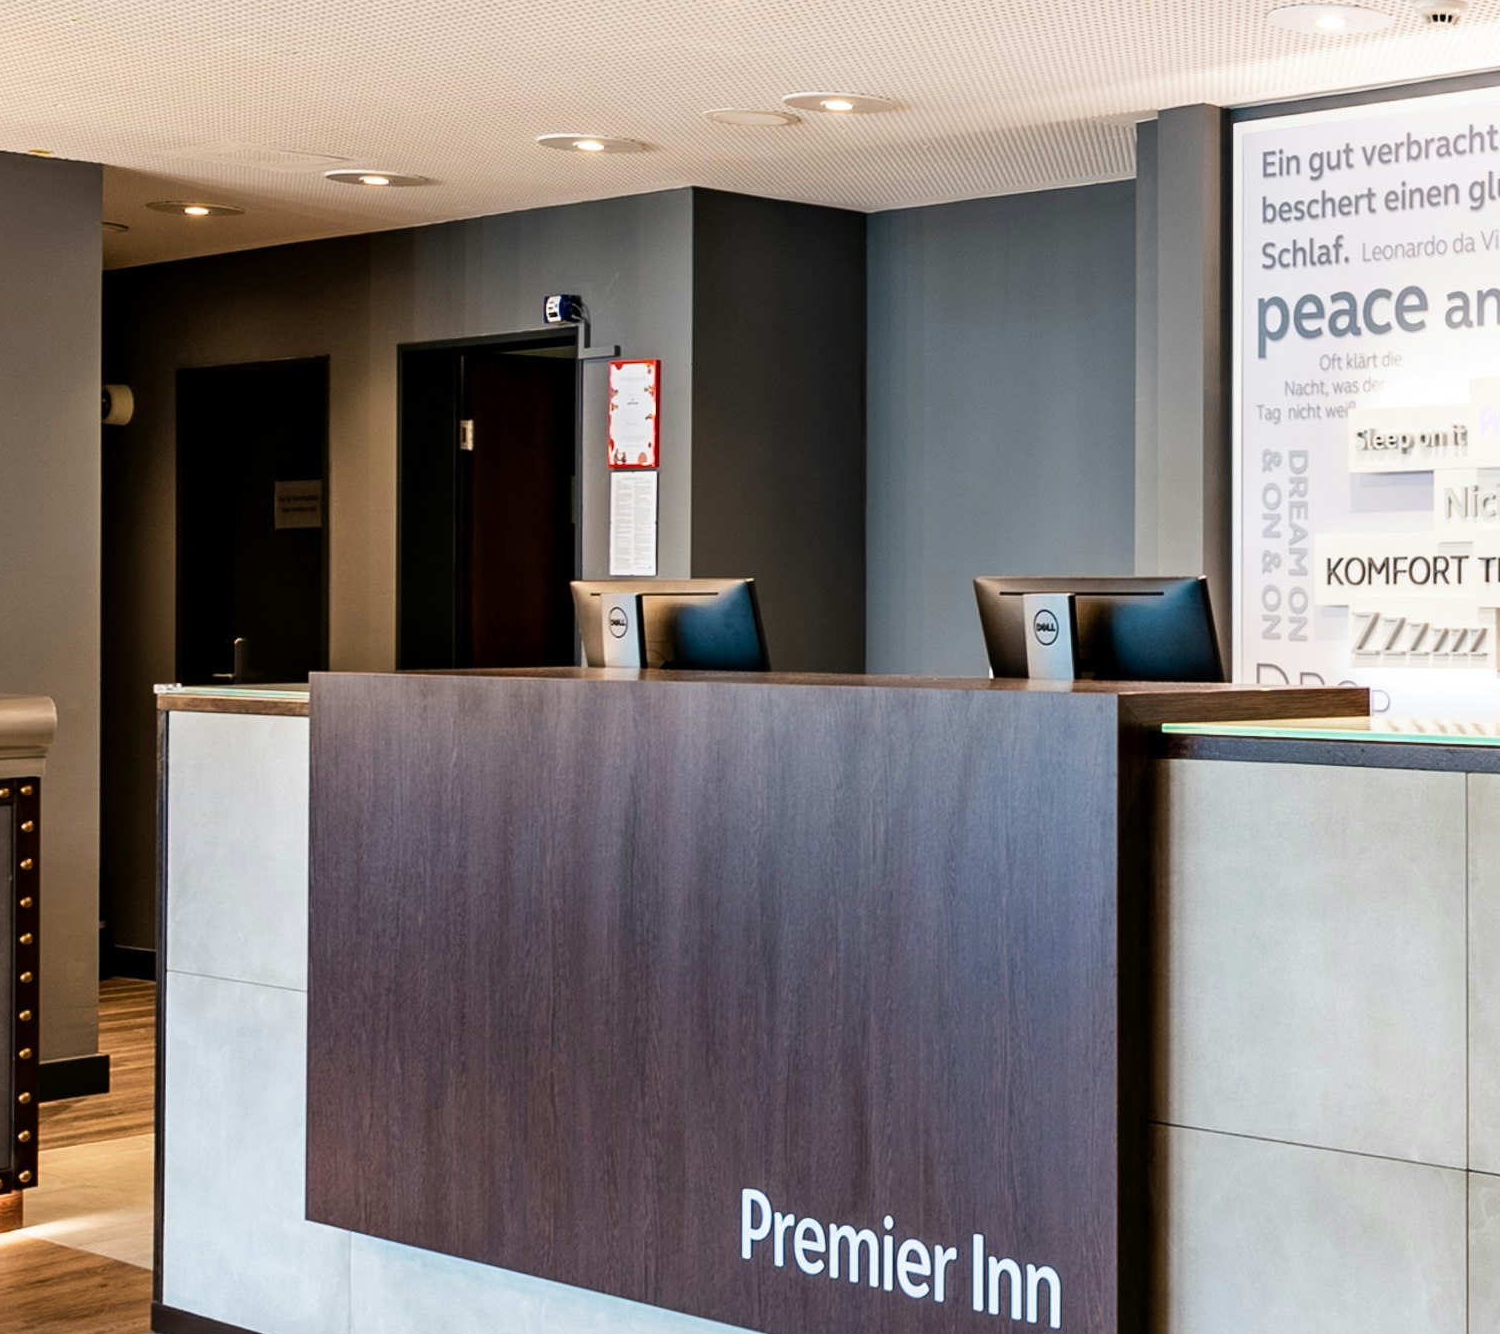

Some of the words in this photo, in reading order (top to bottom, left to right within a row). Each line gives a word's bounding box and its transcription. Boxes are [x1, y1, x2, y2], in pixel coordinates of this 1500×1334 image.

[1262, 149, 1300, 177] Ein
[1309, 142, 1353, 179] gut
[1262, 186, 1376, 223] beschert
[1384, 181, 1459, 212] einen
[1262, 235, 1349, 269] Schlaf.
[1362, 234, 1447, 262] Leonardo
[1453, 233, 1475, 253] da
[1257, 284, 1429, 360] peace
[1319, 353, 1342, 371] Oft
[1346, 352, 1378, 369] klärt
[1382, 351, 1403, 368] die
[1284, 378, 1329, 397] Nacht,
[1333, 378, 1359, 394] was
[1363, 375, 1385, 393] der
[1257, 403, 1281, 424] Tag
[1288, 401, 1322, 420] nicht
[1356, 427, 1415, 454] Sleep
[1420, 430, 1448, 448] on
[1452, 423, 1468, 447] it
[1261, 448, 1282, 473] &
[1261, 482, 1282, 539] ON
[1288, 450, 1309, 577] DREAM
[1261, 548, 1282, 574] &
[1326, 555, 1469, 585] KOMFORT
[1261, 583, 1282, 641] ON
[1288, 585, 1309, 643] ON
[741, 1187, 958, 1303] Premier
[972, 1233, 1062, 1330] Inn
